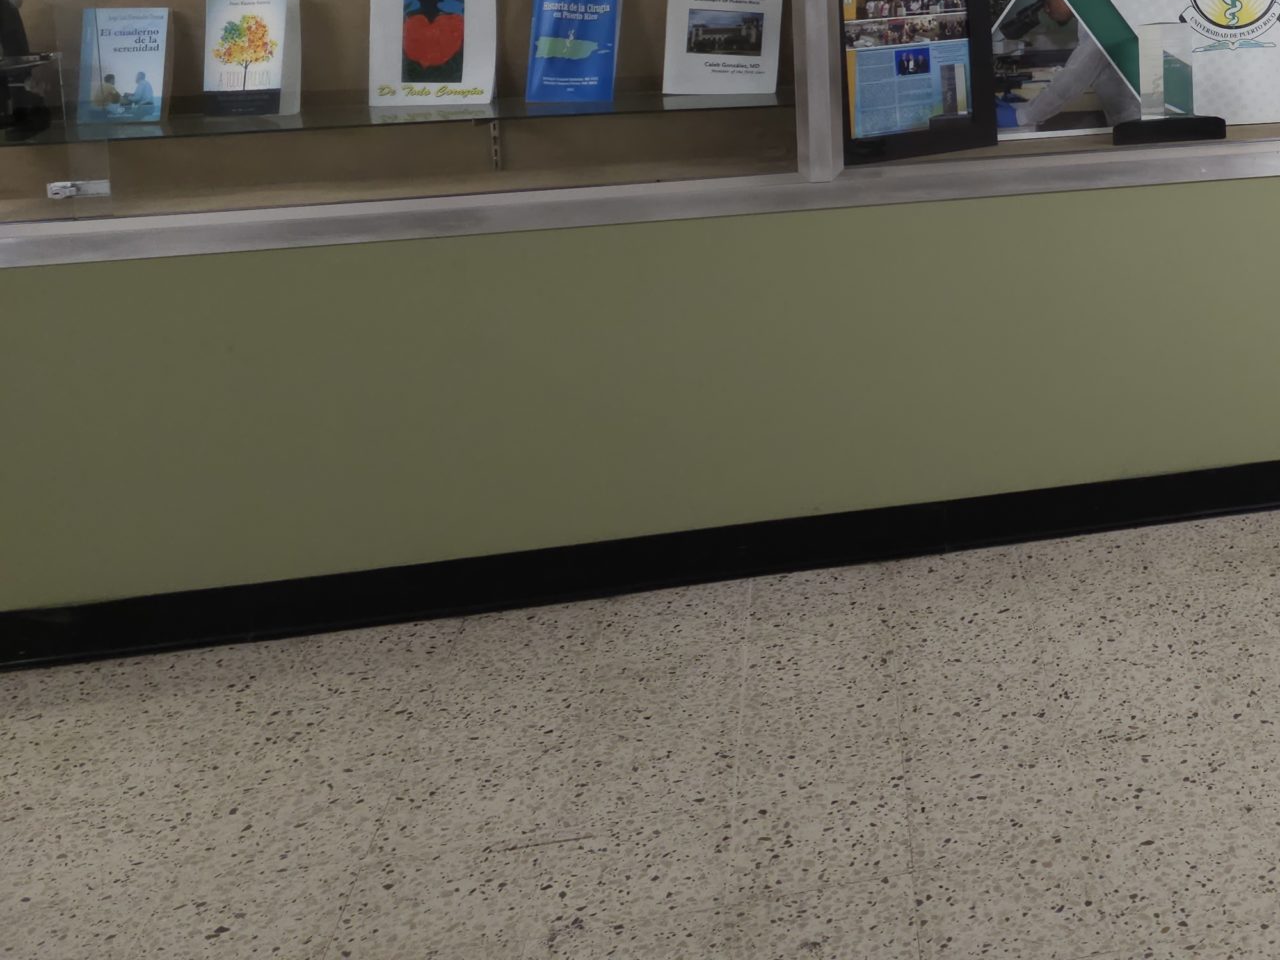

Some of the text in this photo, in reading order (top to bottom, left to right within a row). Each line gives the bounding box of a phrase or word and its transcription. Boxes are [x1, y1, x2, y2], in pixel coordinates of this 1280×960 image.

[543, 2, 568, 11] Historia
[587, 4, 610, 14] Cirugía
[563, 12, 582, 20] Puerto
[1190, 16, 1229, 39] UNIVERSIDAD
[1239, 25, 1263, 38] PUERTO
[1262, 12, 1276, 27] RICO
[114, 28, 159, 36] cuaderno
[113, 44, 159, 53] serenidad
[377, 86, 396, 96] De
[402, 85, 432, 97] Todo
